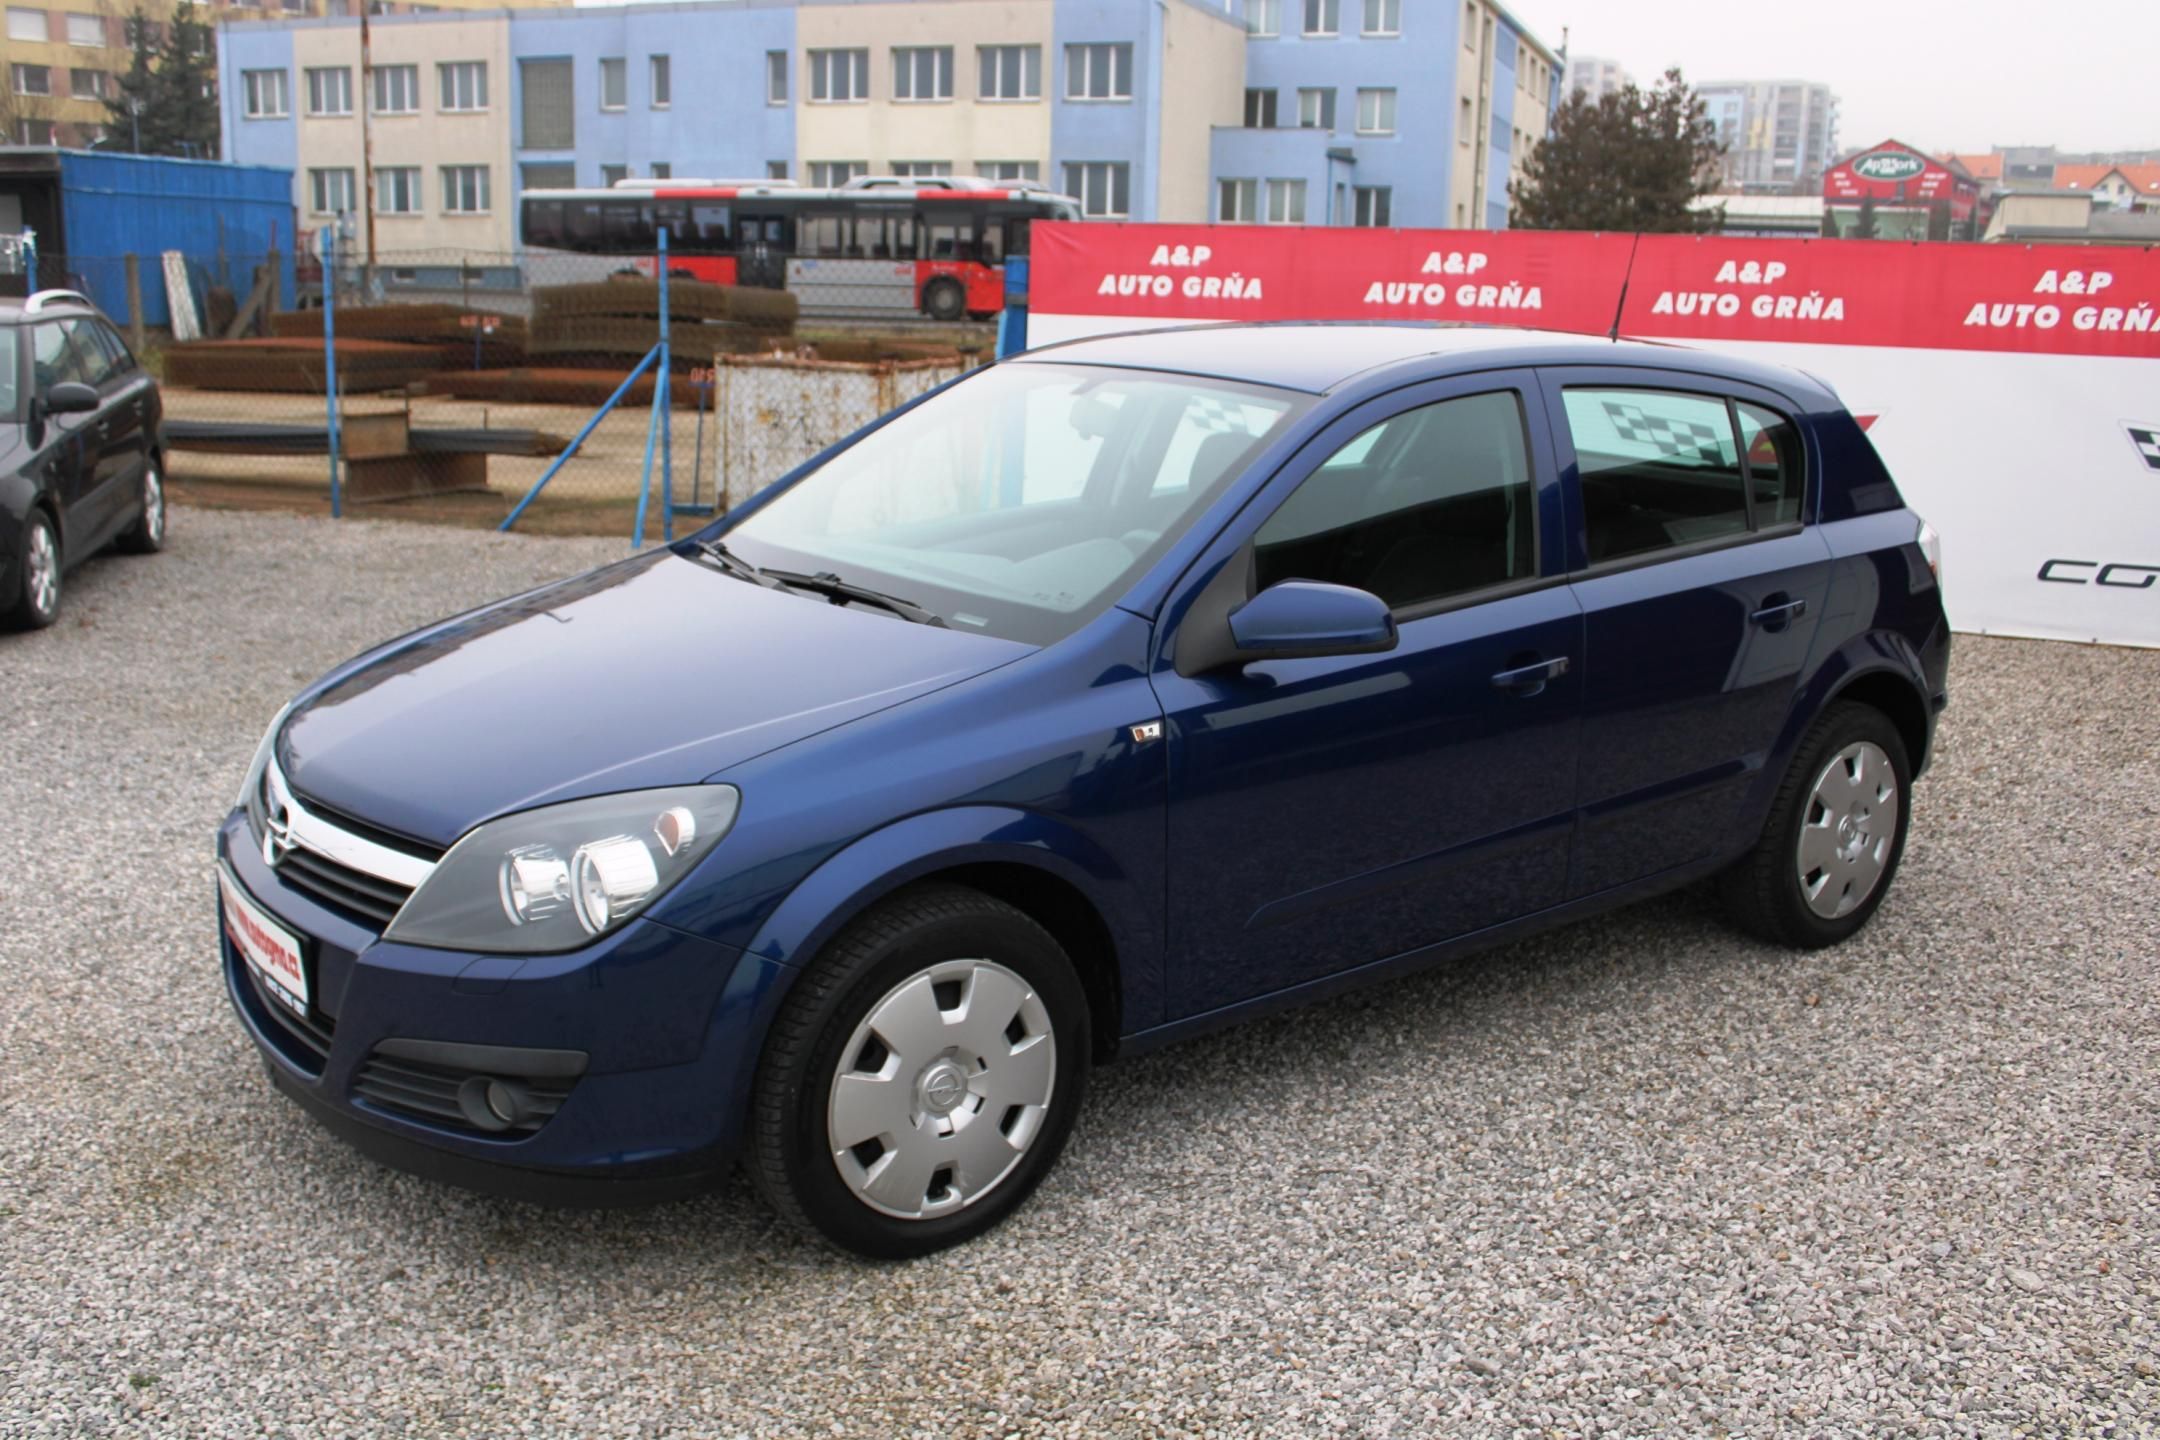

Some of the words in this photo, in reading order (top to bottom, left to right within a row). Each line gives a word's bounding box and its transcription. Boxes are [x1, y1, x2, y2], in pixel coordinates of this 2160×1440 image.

[1150, 244, 1212, 267] A&P
[1421, 251, 1488, 275] A&P
[1097, 274, 1174, 297] AUTO
[1182, 271, 1263, 299] GRŇA
[1714, 260, 1787, 285] A&P
[2033, 270, 2113, 295] A&P
[1363, 281, 1446, 306] AUTO
[1455, 279, 1542, 309] GRŇA
[1651, 291, 1740, 317] AUTO
[1751, 290, 1844, 320] GRŇA
[1963, 302, 2060, 329] AUTO
